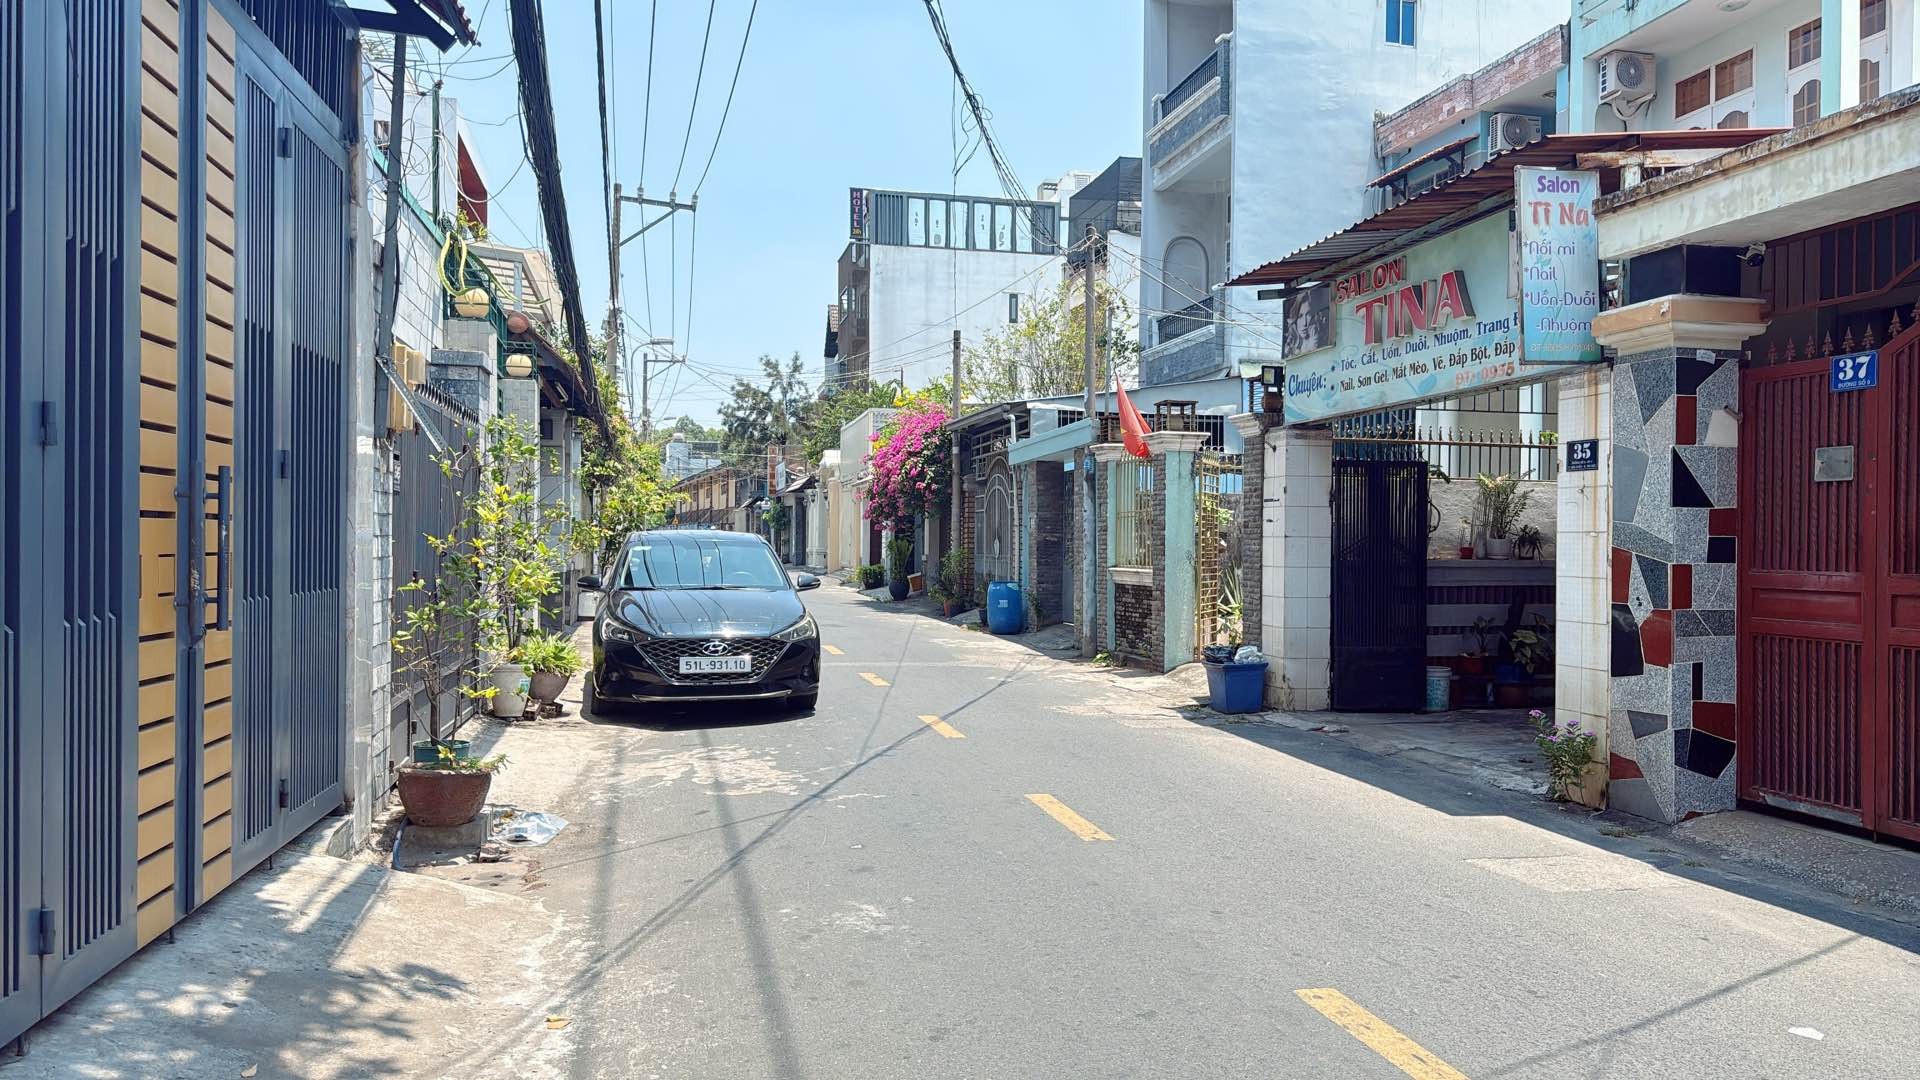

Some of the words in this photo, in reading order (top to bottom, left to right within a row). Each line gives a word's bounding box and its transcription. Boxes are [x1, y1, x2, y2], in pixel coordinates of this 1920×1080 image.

[1537, 175, 1580, 194] Salon
[852, 191, 861, 228] HOTEL
[1559, 201, 1589, 226] Na
[1557, 241, 1575, 255] mi
[1336, 256, 1406, 305] SALON
[1355, 271, 1470, 345] TINA
[1433, 327, 1472, 346] Nhuộm,
[1476, 317, 1510, 336] Trang
[1470, 345, 1491, 364] Bột,
[1838, 356, 1872, 381] 37
[1288, 371, 1327, 398] Chuyên:
[1573, 443, 1591, 459] 35
[685, 660, 746, 671] 51L-931.10
